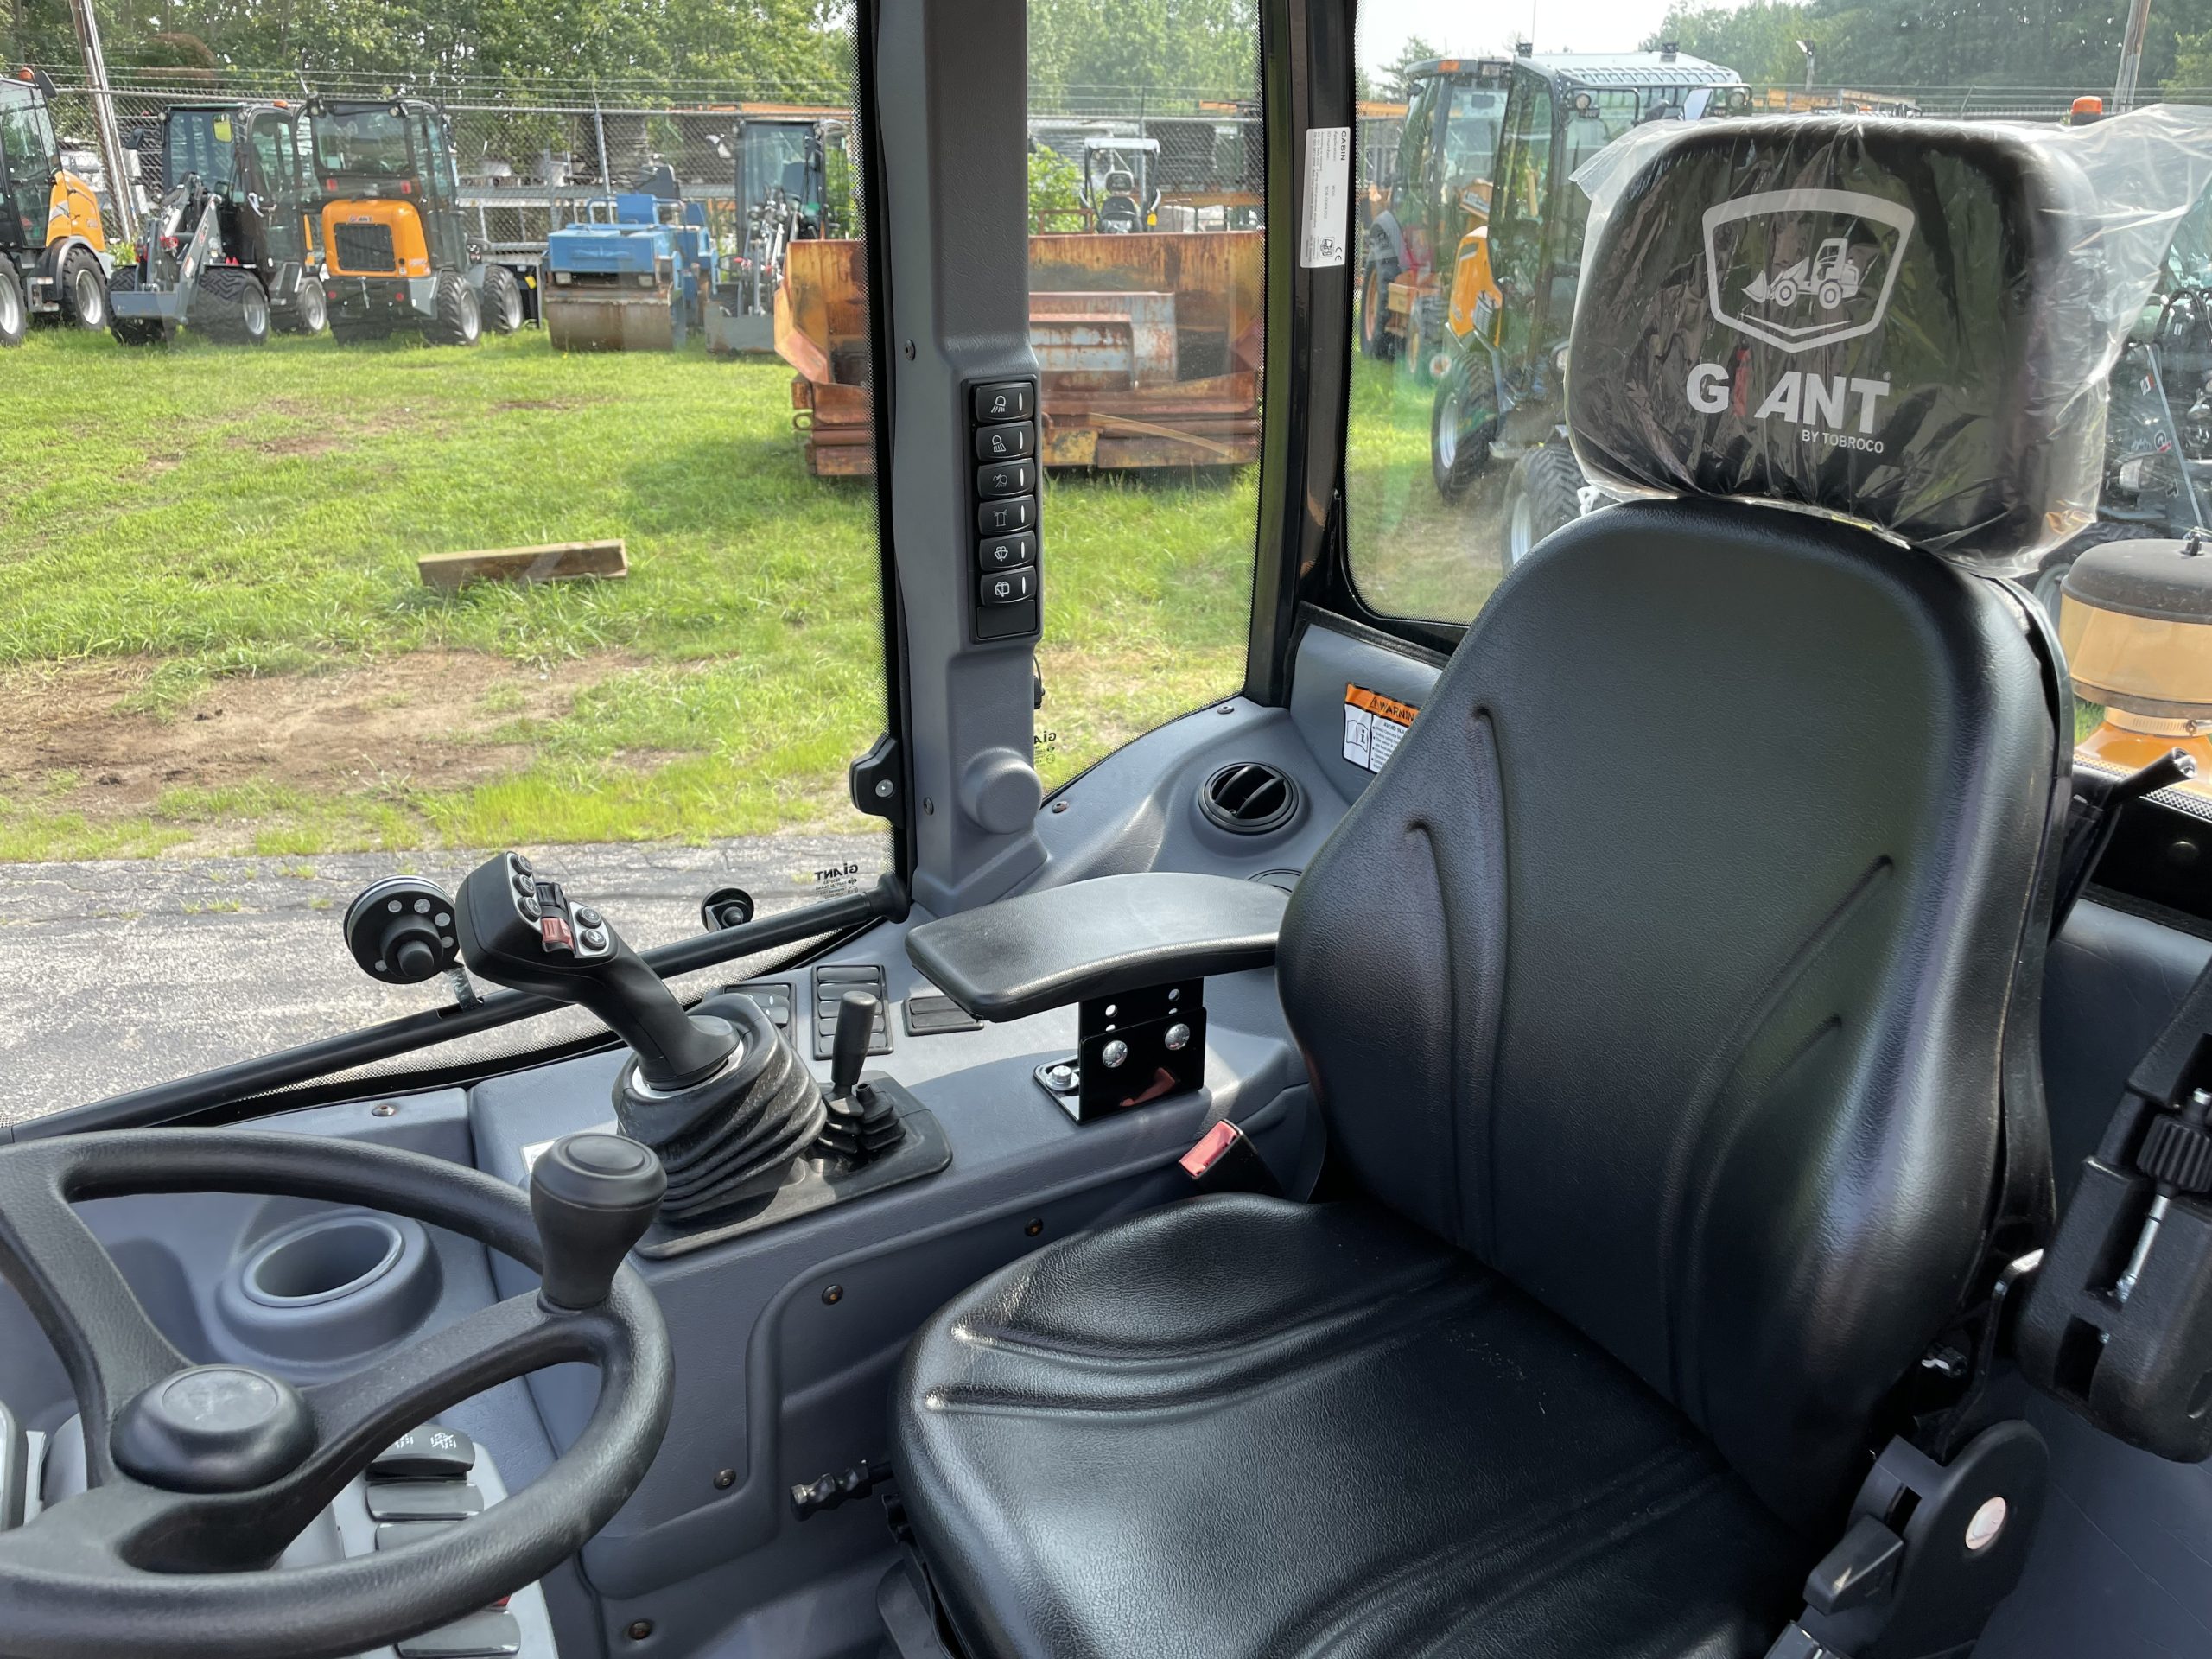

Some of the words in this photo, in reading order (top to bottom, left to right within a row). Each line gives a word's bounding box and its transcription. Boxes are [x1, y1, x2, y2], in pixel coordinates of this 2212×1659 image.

[1802, 429, 1819, 443] BY
[1822, 432, 1884, 454] TOBROCO
[1380, 702, 1414, 721] WARNIN
